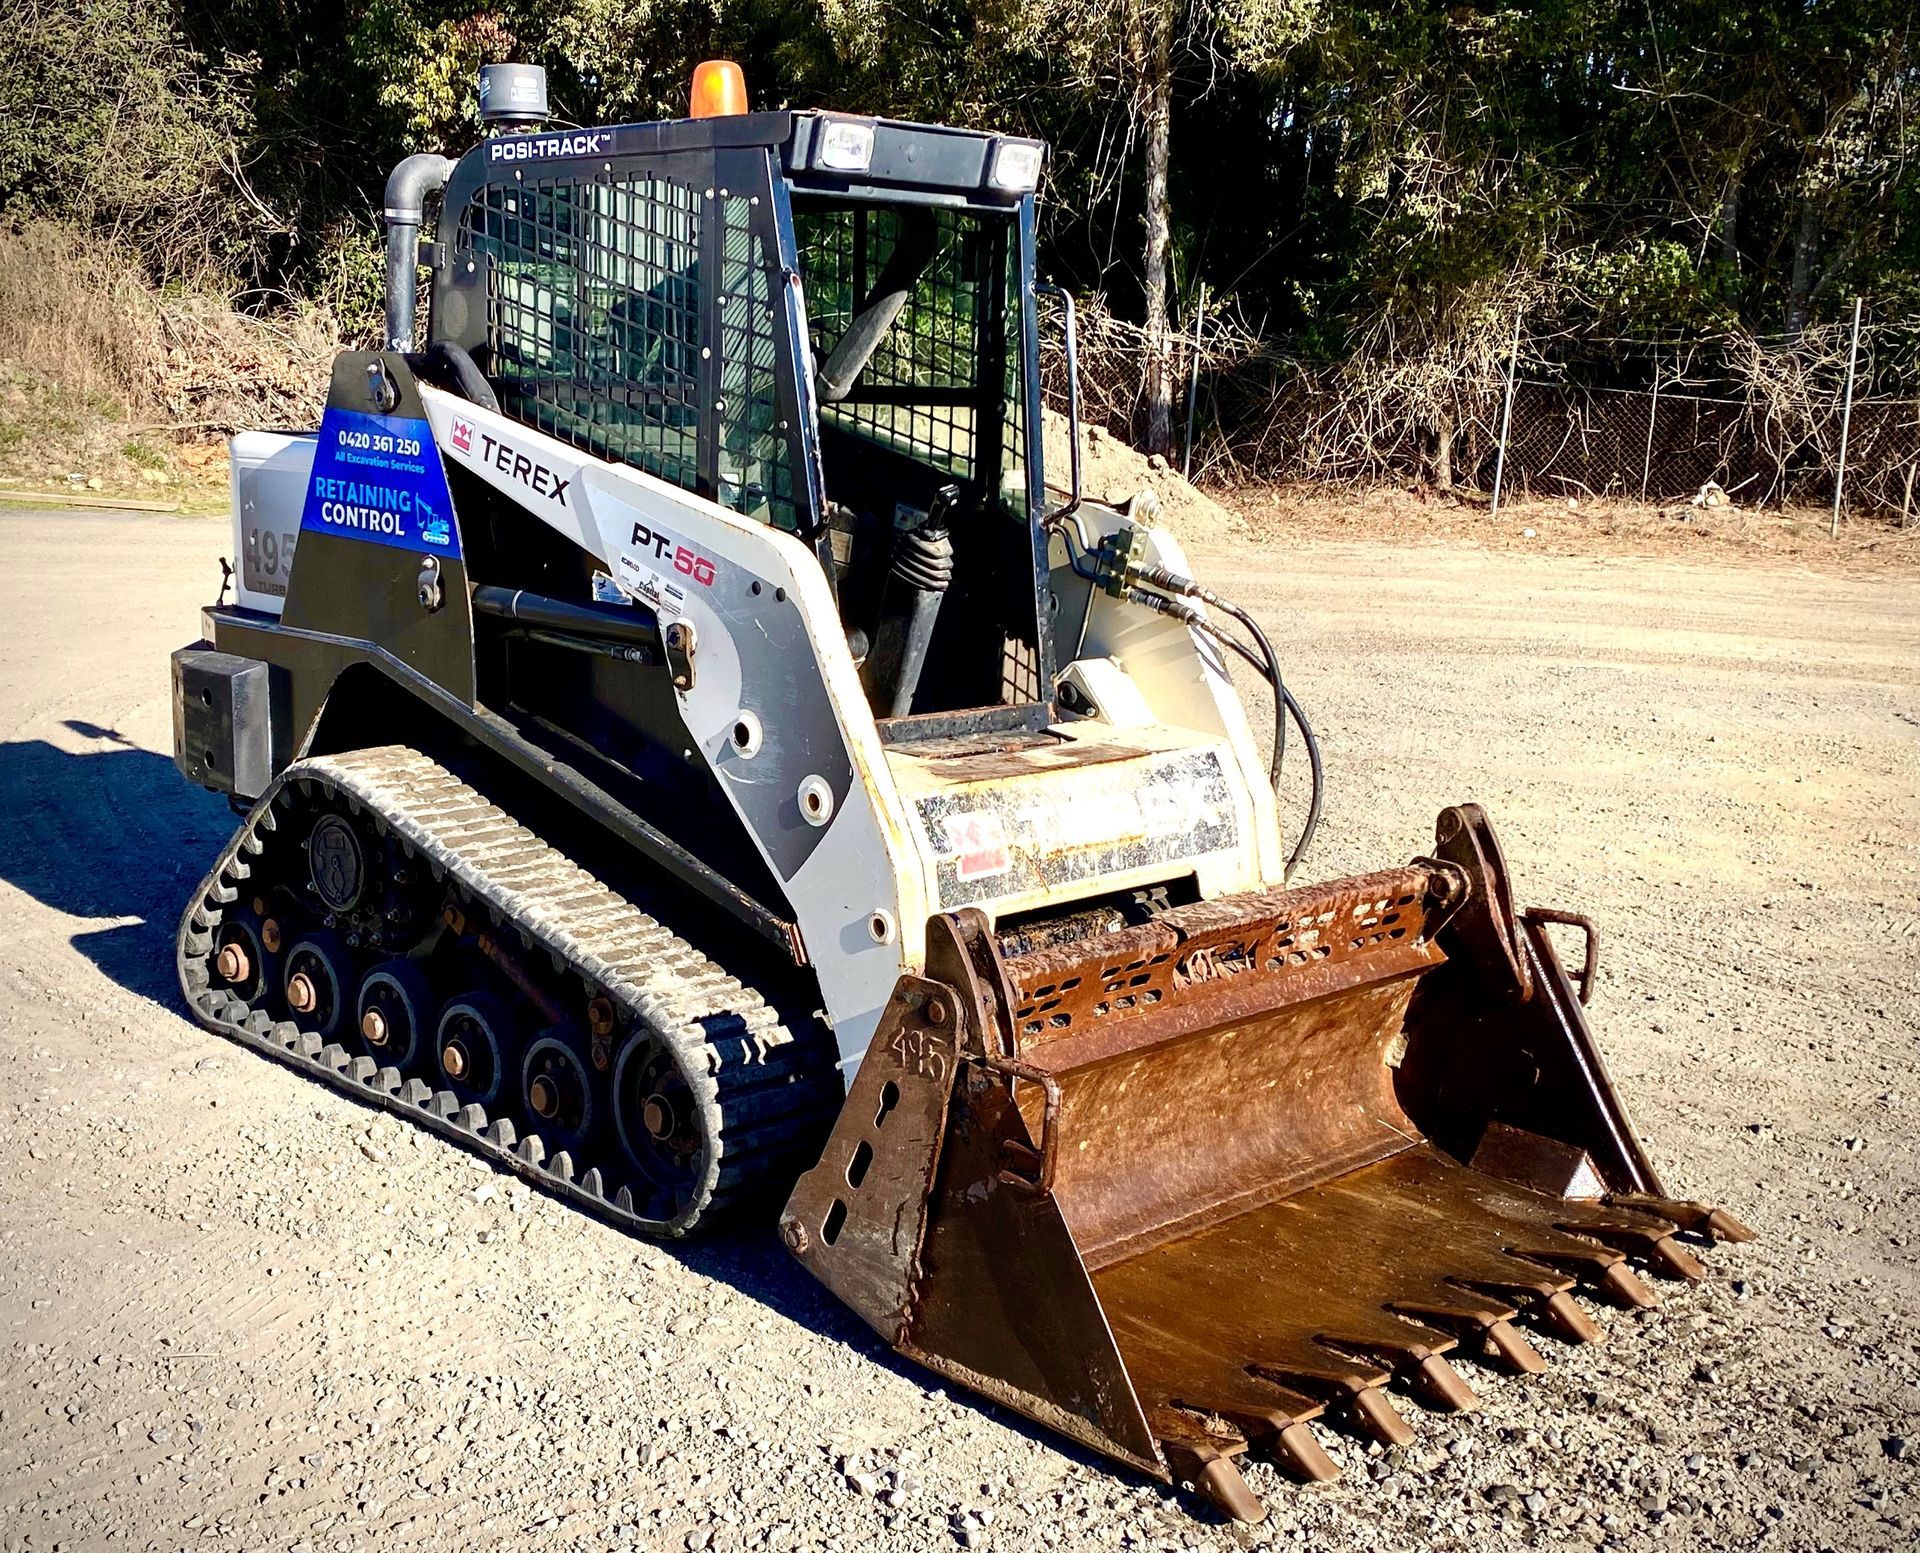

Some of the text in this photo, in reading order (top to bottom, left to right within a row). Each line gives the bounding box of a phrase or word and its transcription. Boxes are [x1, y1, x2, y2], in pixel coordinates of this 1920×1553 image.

[335, 451, 425, 474] All Excavation Services
[338, 430, 421, 457] 0420 361 250
[481, 433, 571, 507] TEREX
[315, 476, 412, 513] RETAINING
[321, 501, 406, 537] CONTROL
[246, 528, 296, 578] 495
[630, 521, 717, 588] PT-50
[892, 1026, 948, 1083] 495
